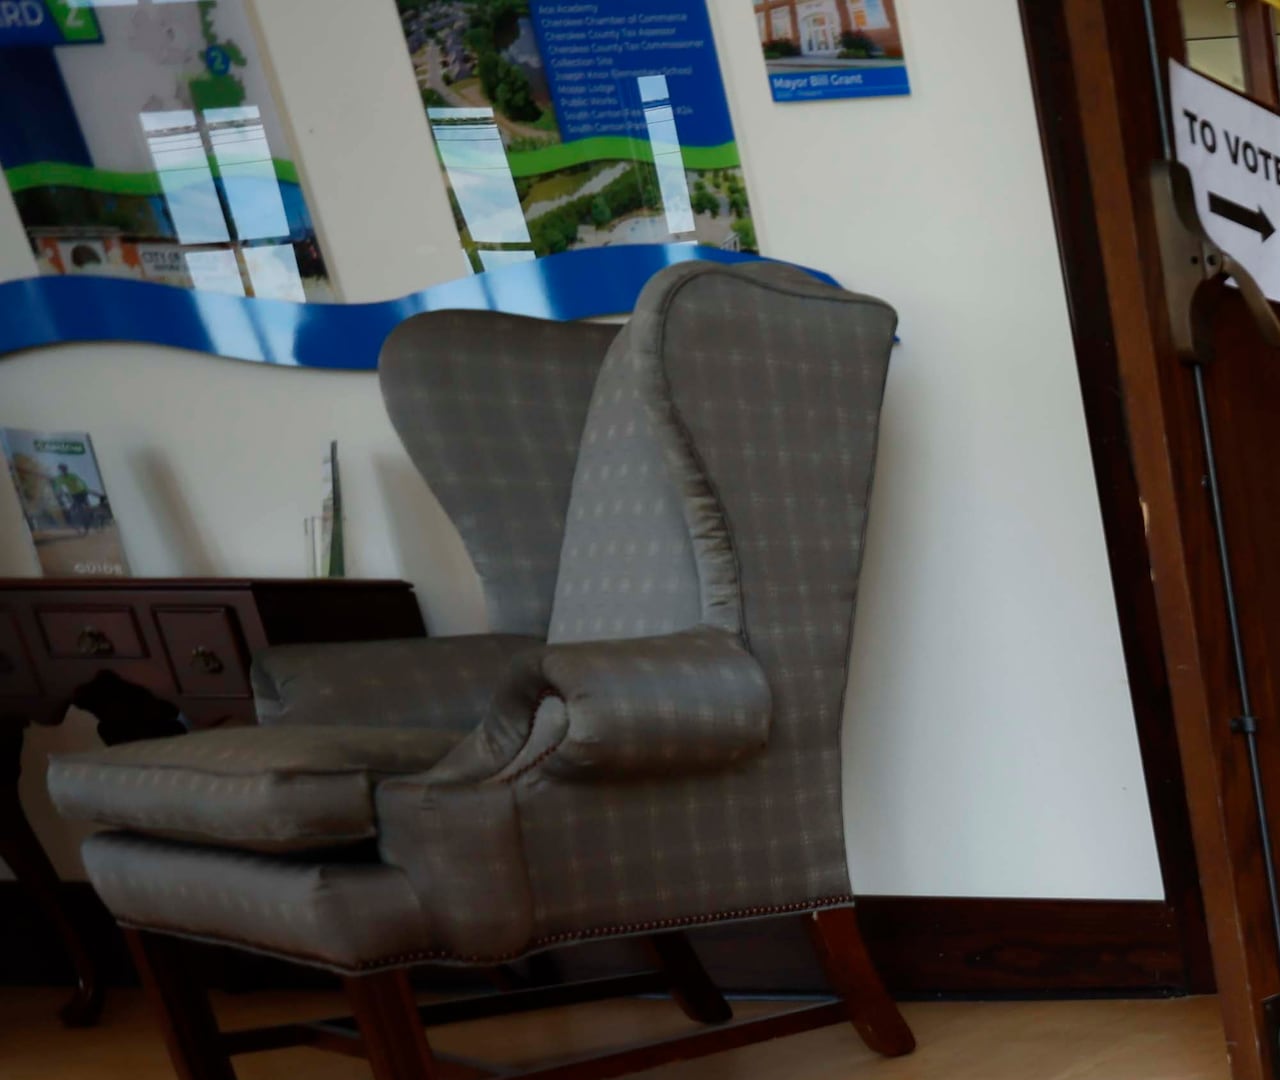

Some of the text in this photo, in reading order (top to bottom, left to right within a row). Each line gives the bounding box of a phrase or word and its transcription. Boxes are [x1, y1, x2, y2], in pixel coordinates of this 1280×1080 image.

[0, 1, 44, 27] RD
[210, 52, 224, 70] 2
[773, 74, 863, 90] Mayor Bill Grant
[1182, 108, 1217, 154] TO
